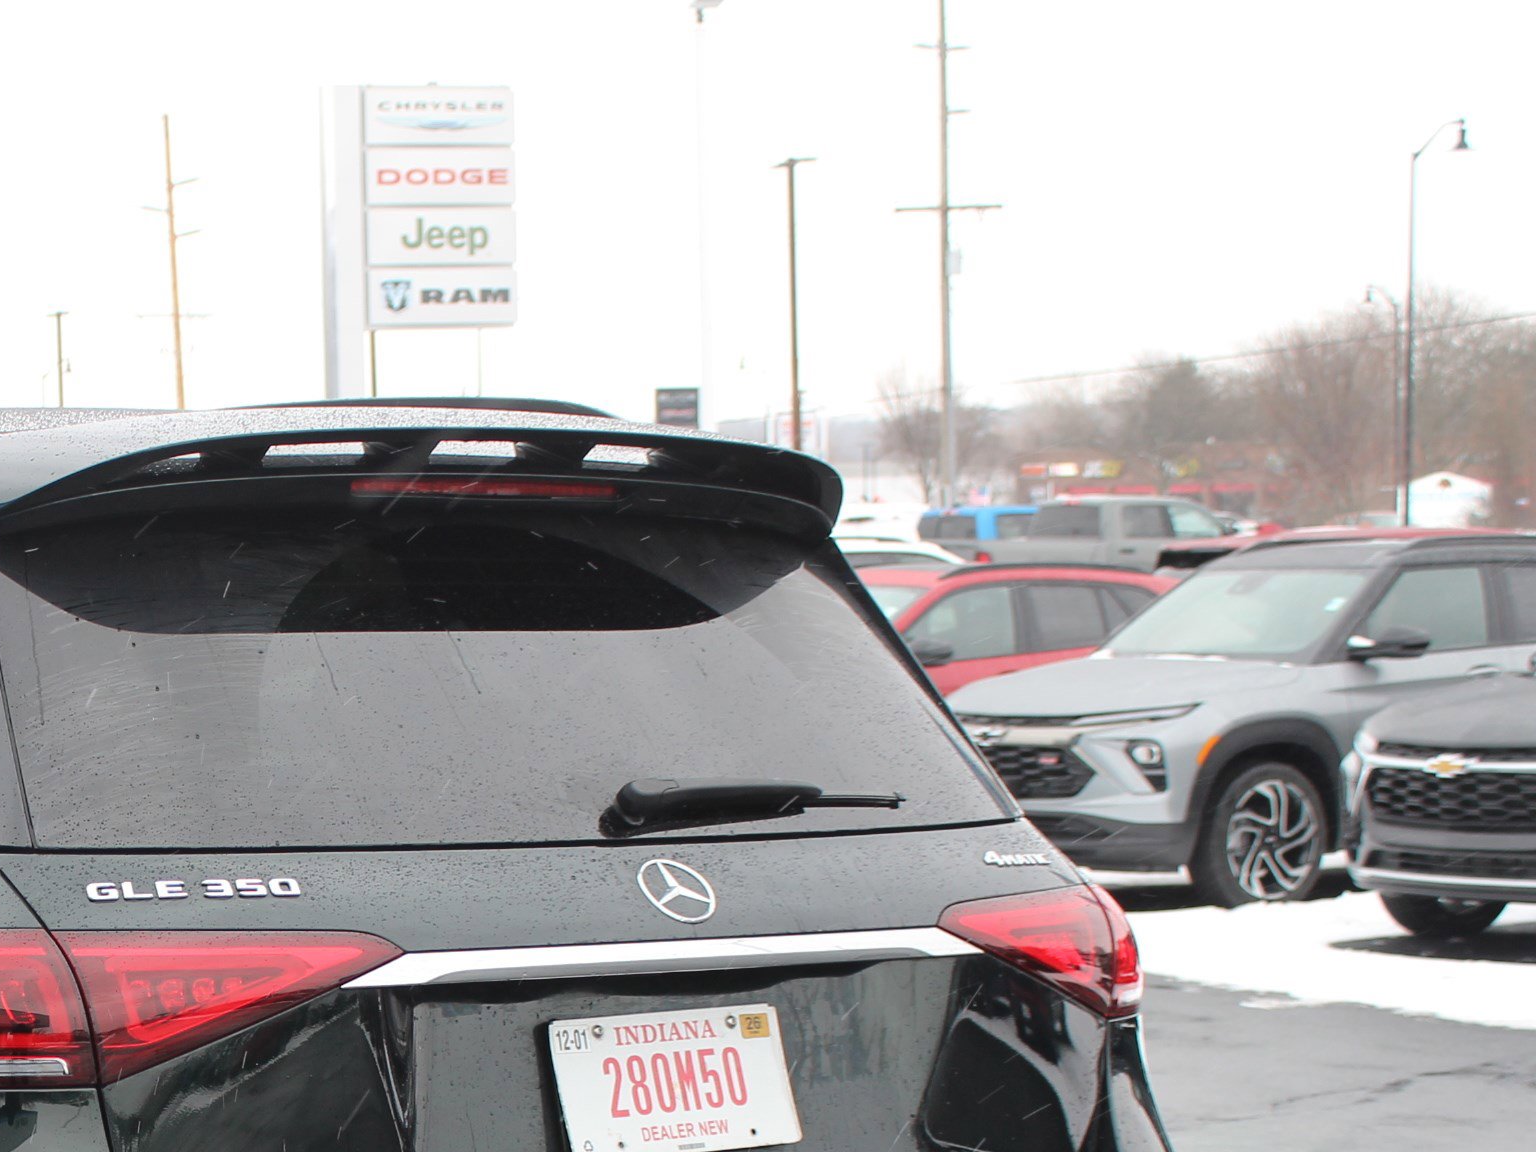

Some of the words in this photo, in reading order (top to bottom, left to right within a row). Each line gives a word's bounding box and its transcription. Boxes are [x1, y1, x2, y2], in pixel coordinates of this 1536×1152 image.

[377, 100, 505, 112] CHRYSLER
[376, 168, 510, 186] DODGE
[401, 217, 489, 256] Jeep
[420, 288, 511, 305] RAM
[85, 880, 189, 902] GLE
[201, 878, 302, 899] 350
[614, 1018, 717, 1046] INDIANA
[744, 1016, 763, 1031] 26
[555, 1028, 588, 1051] 12-01
[602, 1046, 748, 1118] 280M50
[640, 1122, 695, 1142] DEALER
[699, 1119, 729, 1136] NEW
